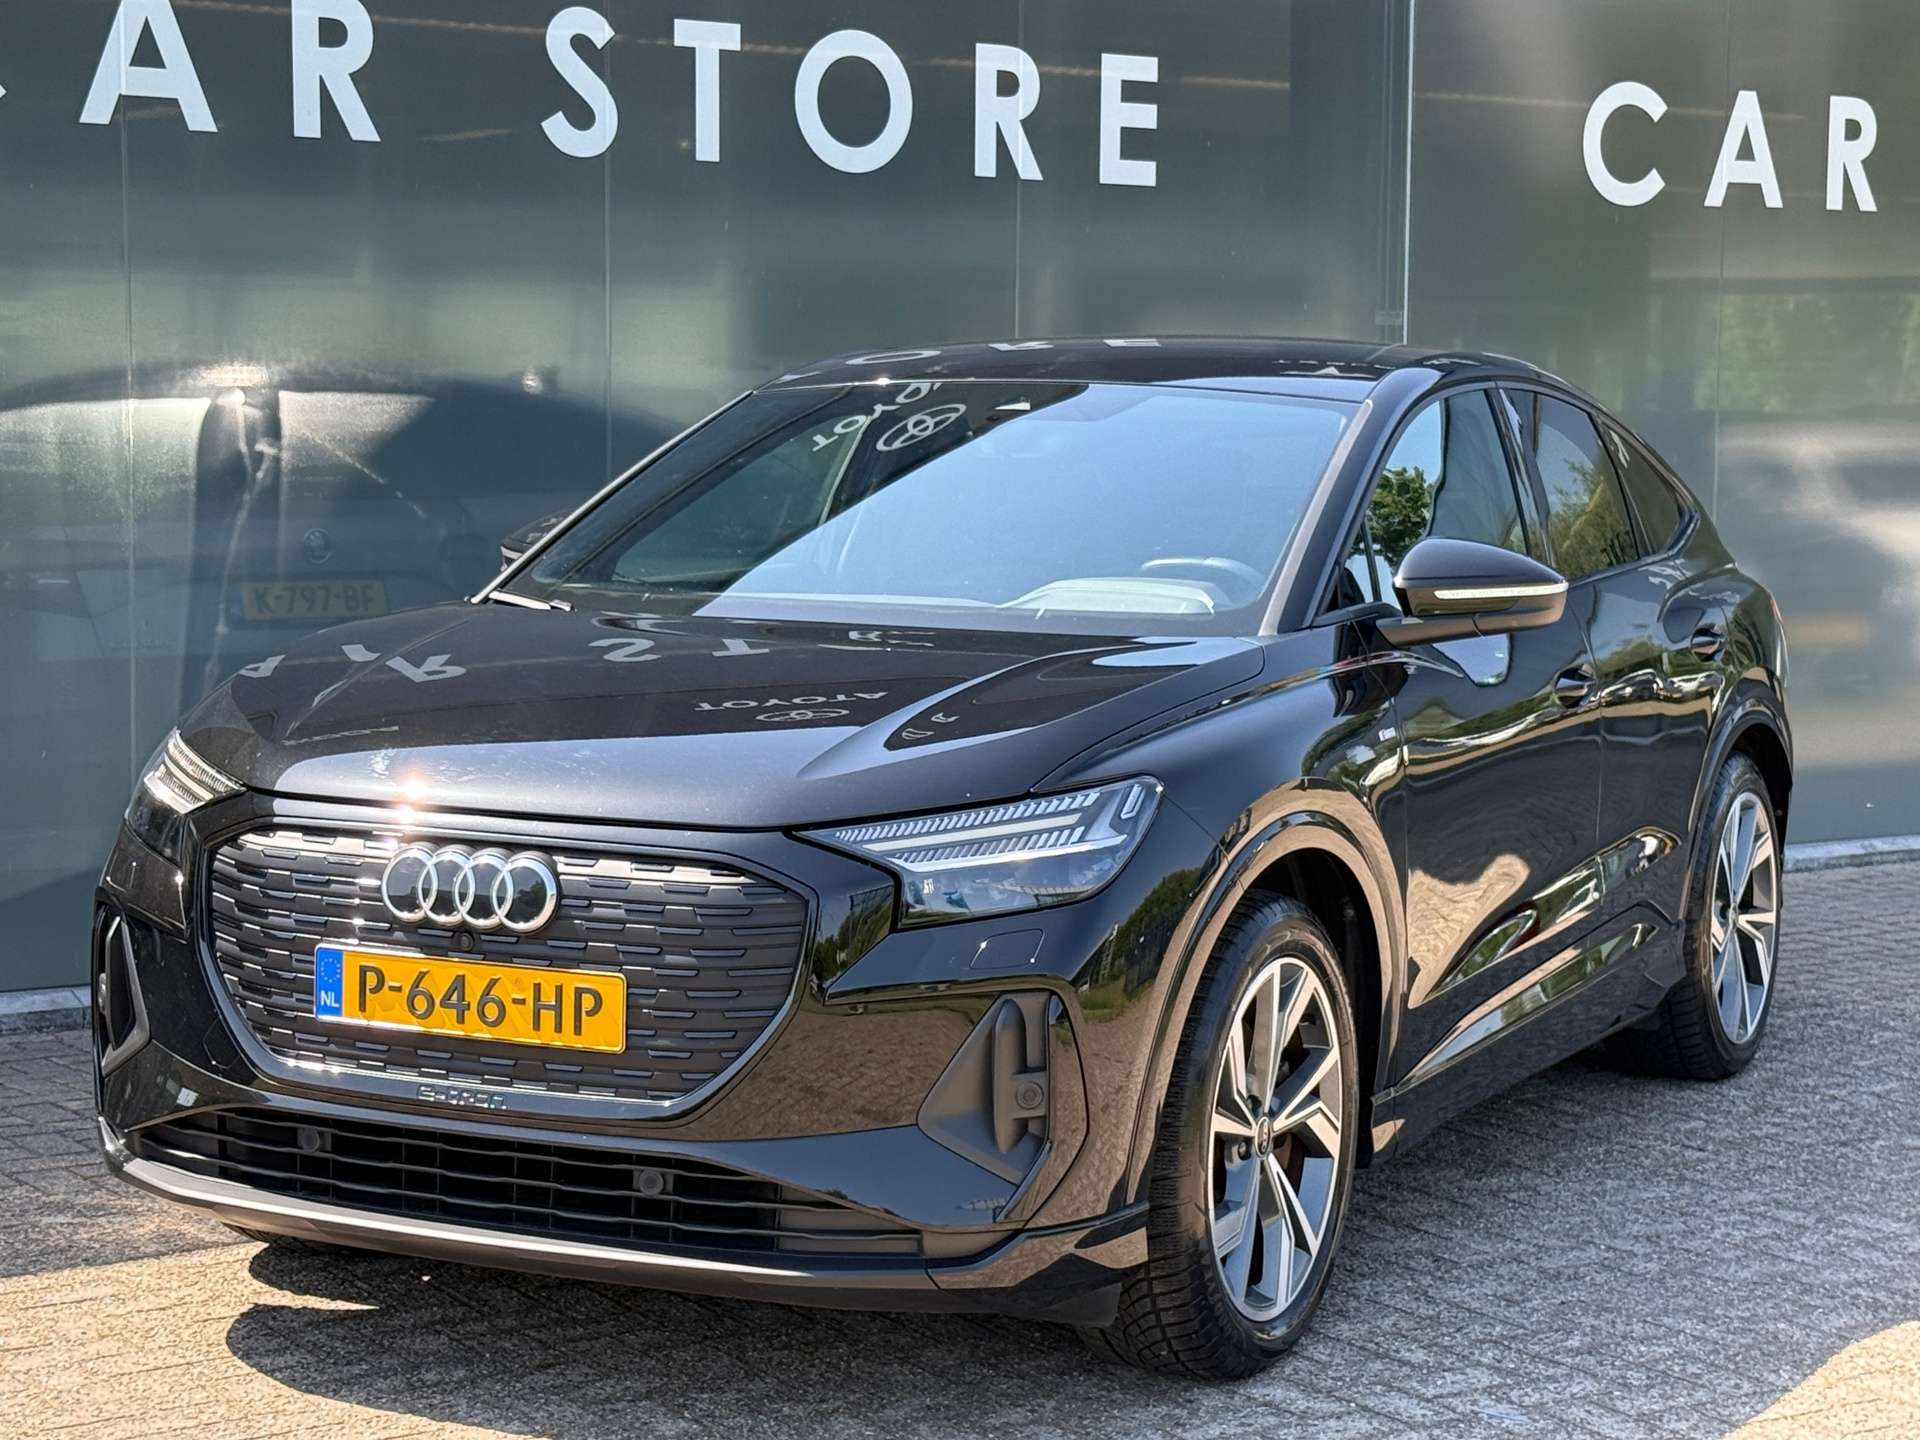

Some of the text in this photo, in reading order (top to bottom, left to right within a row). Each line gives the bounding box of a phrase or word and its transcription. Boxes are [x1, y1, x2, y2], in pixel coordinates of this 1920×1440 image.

[0, 0, 1159, 187] AR STORE
[1582, 81, 1878, 212] CAR
[254, 583, 375, 615] K-797-BF
[320, 961, 604, 1037] NL P-646-HP
